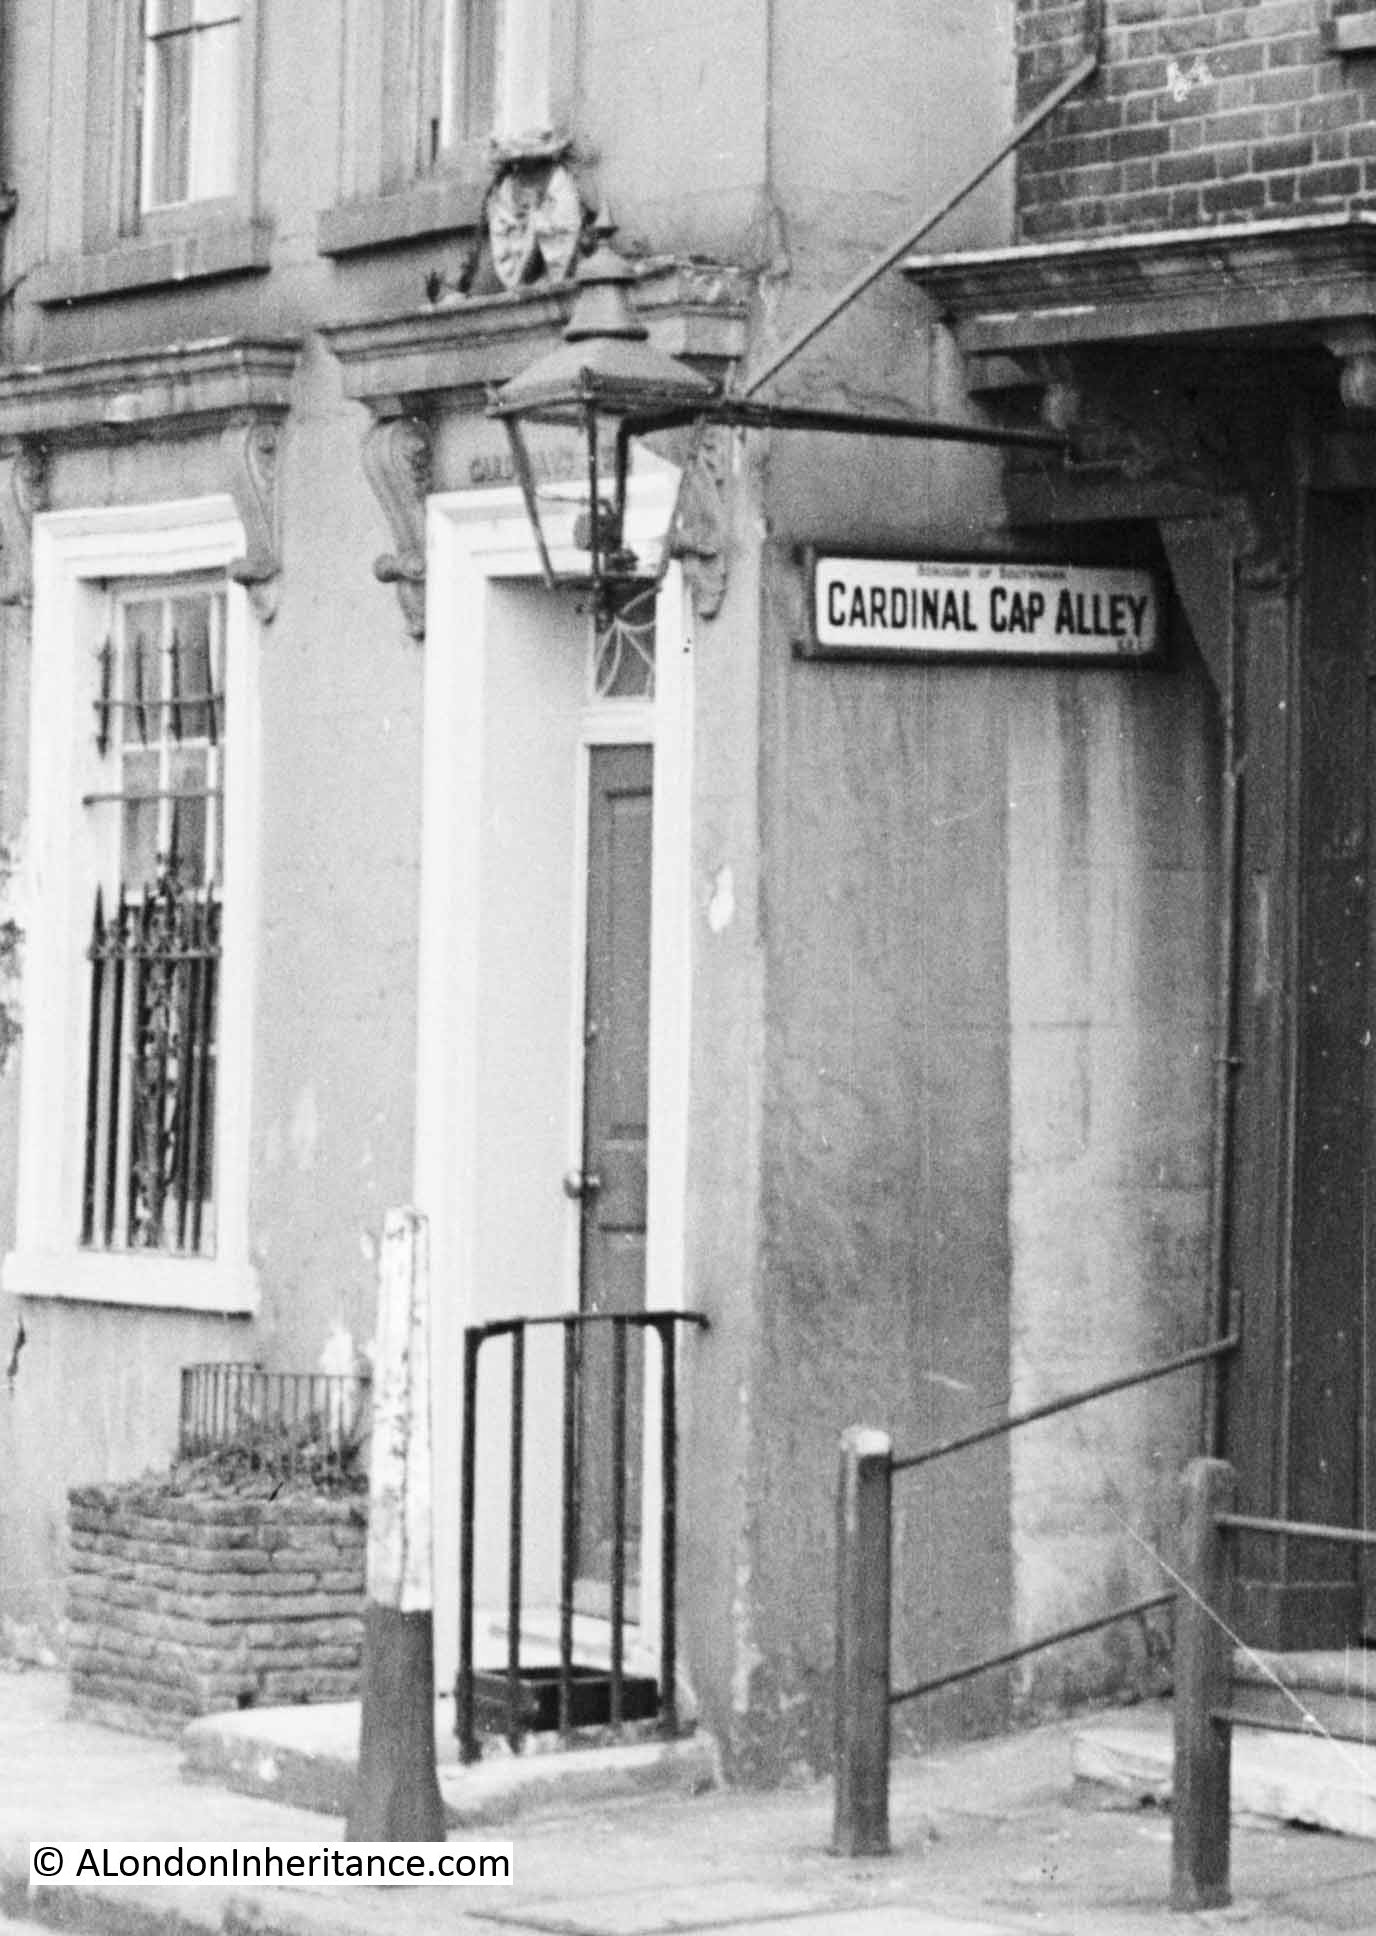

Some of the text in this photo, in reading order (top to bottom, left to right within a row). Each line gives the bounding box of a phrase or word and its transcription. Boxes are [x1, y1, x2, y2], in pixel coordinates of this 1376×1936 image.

[828, 581, 1148, 637] CARDINAL CAP ALLEY
